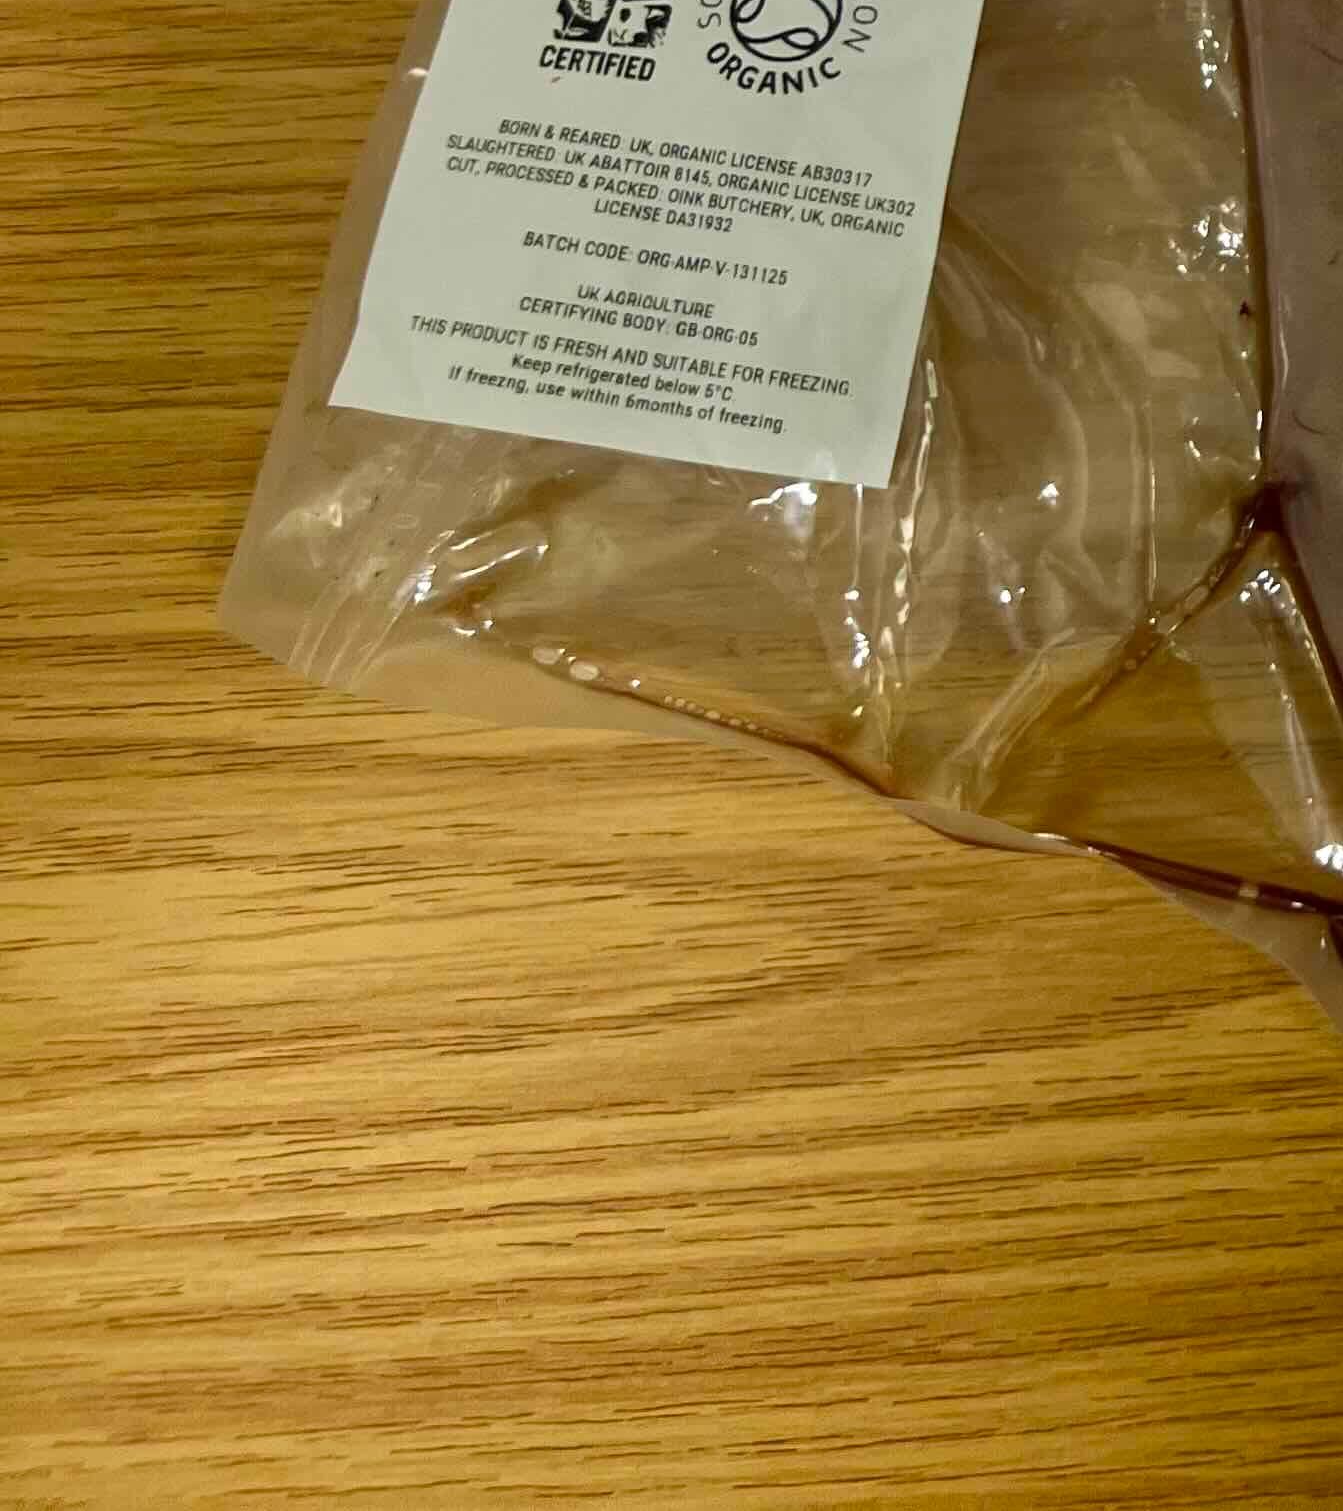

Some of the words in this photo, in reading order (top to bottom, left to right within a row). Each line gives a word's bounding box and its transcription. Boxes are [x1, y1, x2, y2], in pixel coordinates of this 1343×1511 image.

[539, 44, 656, 82] CERTIFIED
[706, 41, 841, 95] ORGANIC
[499, 118, 542, 139] BORN
[544, 124, 554, 140] &
[659, 142, 727, 166] ORGANIC
[730, 151, 798, 177] LICENSE
[801, 164, 873, 188] AB30317
[485, 160, 575, 186] PROCESSED
[578, 173, 590, 189] &
[667, 188, 704, 207] OINK
[831, 211, 905, 238] ORGANIC
[564, 149, 586, 166] UK
[588, 153, 670, 179] ABATTOIR
[717, 172, 790, 198] ORGANIC
[794, 184, 862, 209] LICENSE
[864, 195, 916, 218] UK302
[594, 197, 663, 223] LICENSE
[665, 209, 733, 234] DA31932
[523, 230, 580, 254] BATCH
[519, 296, 618, 326] CERTIFYING
[577, 283, 601, 302] UK
[603, 289, 715, 319] AGRICULTURE
[411, 315, 448, 335] THIS
[450, 320, 529, 347] PRODUCT
[533, 333, 550, 351] IS
[552, 336, 609, 360] FRESH
[612, 346, 649, 366] AND
[652, 351, 728, 379] SUITABLE
[731, 363, 765, 385] FOR
[511, 352, 552, 375] Keep
[555, 360, 651, 389] refrigerated
[654, 375, 701, 397] below
[447, 365, 463, 381] If
[535, 381, 566, 397] use
[570, 386, 620, 408] within
[625, 393, 693, 418] 6months
[697, 404, 715, 422] of
